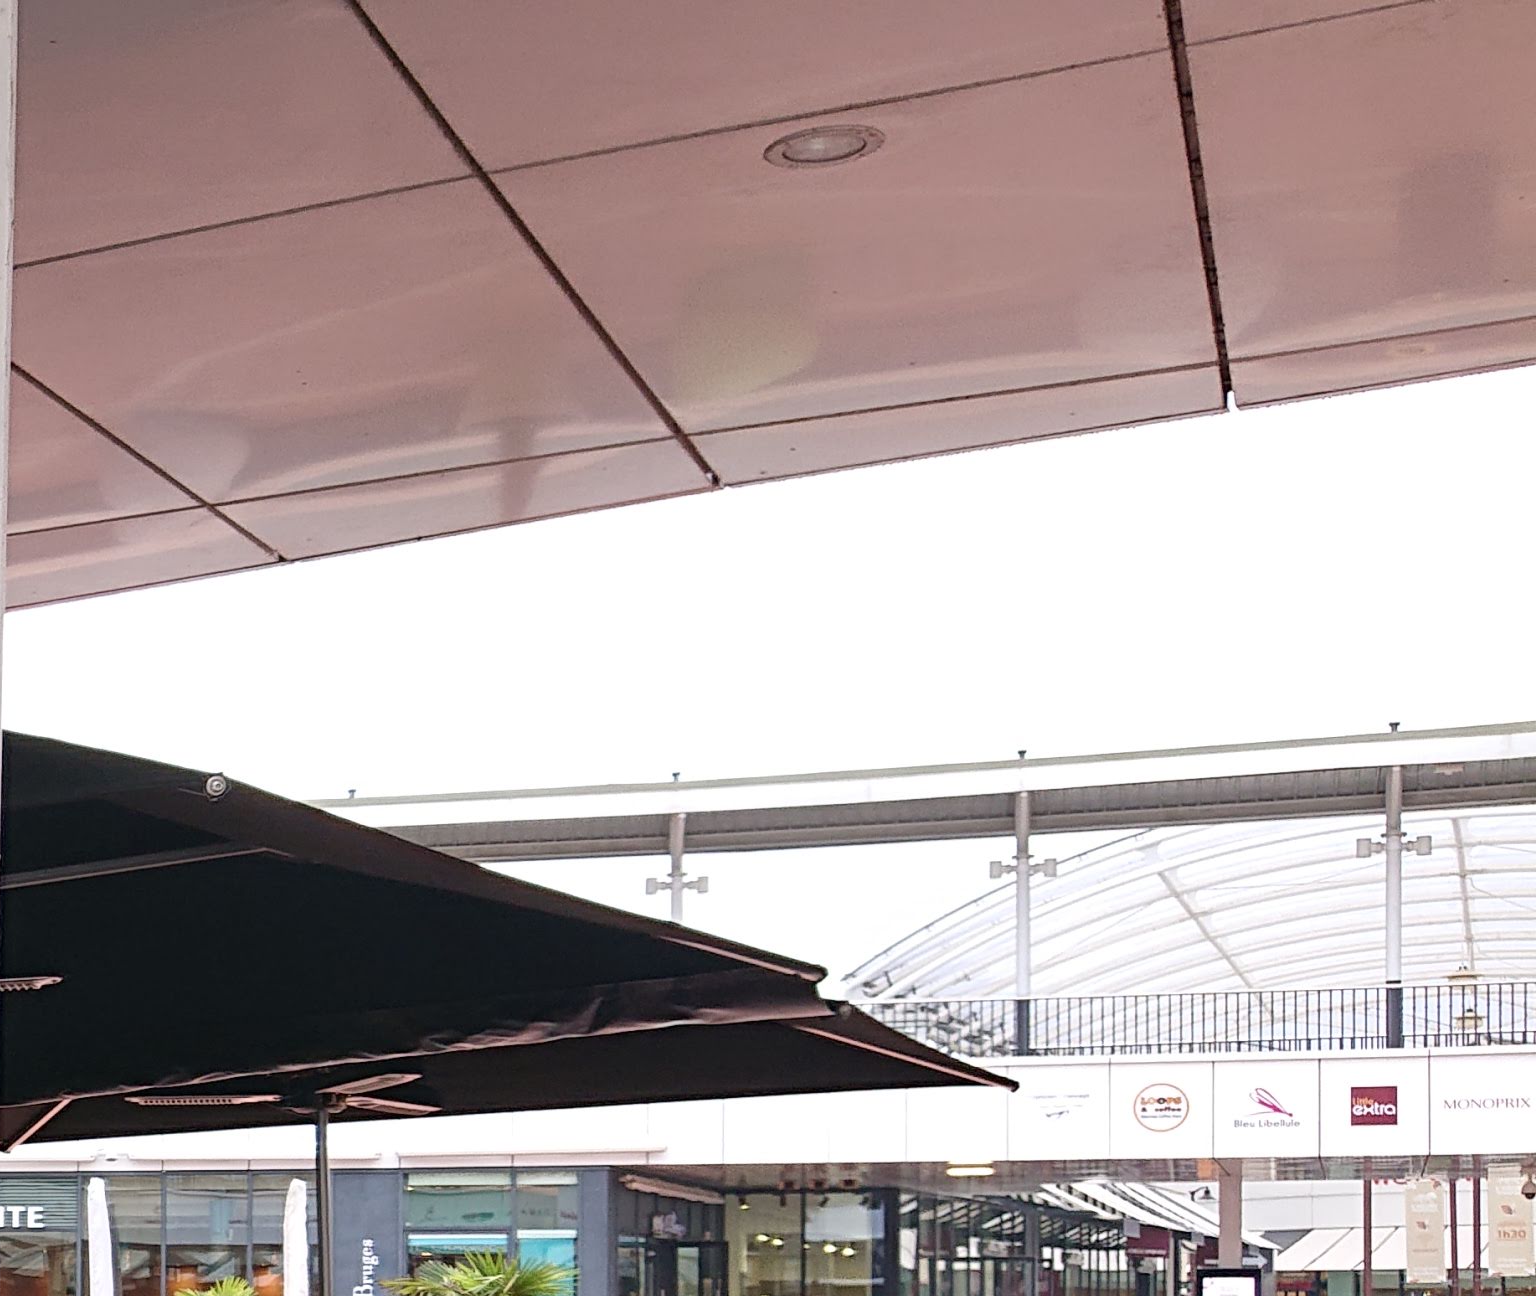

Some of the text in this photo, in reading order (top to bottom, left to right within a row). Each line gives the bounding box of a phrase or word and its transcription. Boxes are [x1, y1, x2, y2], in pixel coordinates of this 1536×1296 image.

[1352, 1102, 1396, 1116] extra
[1443, 1097, 1531, 1111] MONOPRIX
[1234, 1119, 1255, 1128] Bleu
